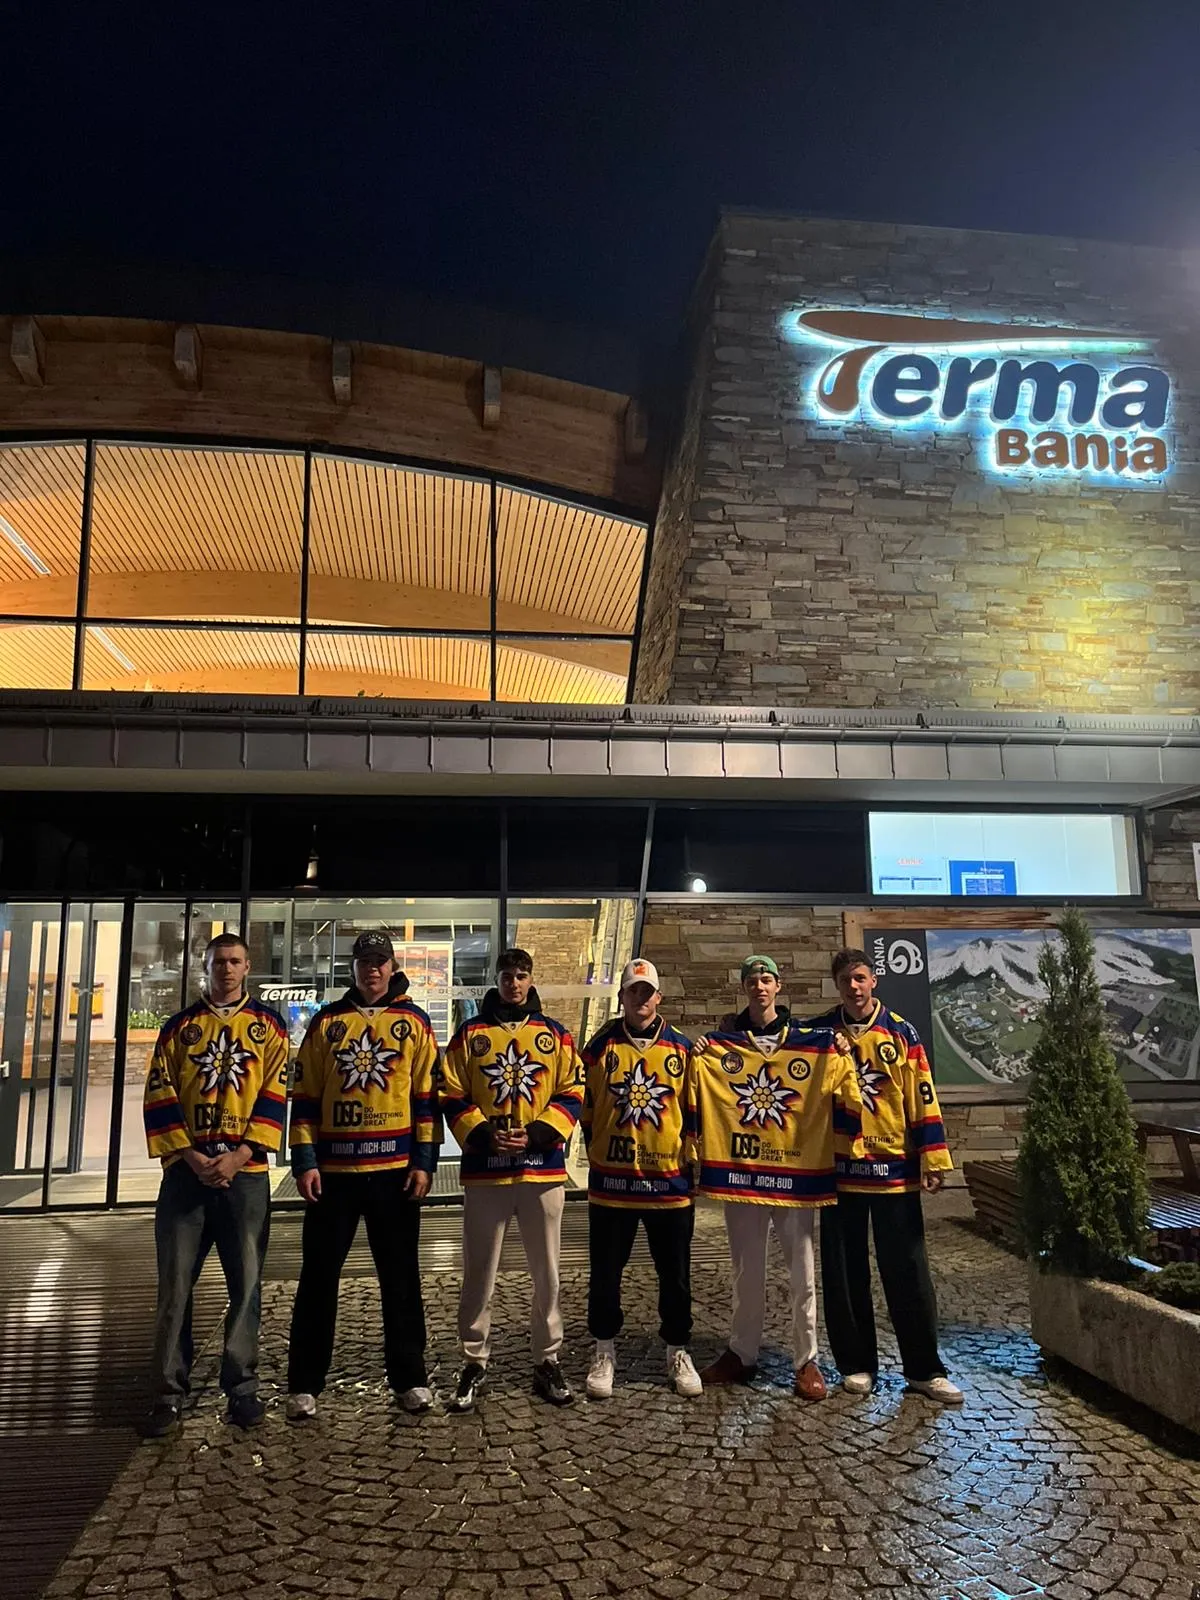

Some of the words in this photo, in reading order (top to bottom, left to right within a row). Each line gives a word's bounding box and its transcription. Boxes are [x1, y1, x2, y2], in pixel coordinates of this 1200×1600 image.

[798, 309, 1171, 432] Terma
[995, 427, 1169, 475] Bania
[873, 937, 886, 976] BANIA
[258, 983, 318, 1003] Terma
[792, 1063, 807, 1075] PZU
[919, 1081, 934, 1105] 9
[333, 1101, 363, 1128] DSG
[364, 1111, 403, 1120] SOMETHING
[357, 1140, 396, 1154] JACH-BUD
[731, 1132, 760, 1159] DSG
[862, 1135, 894, 1143] METHING
[761, 1148, 801, 1157] SOMETHING
[849, 1162, 889, 1176] JACH-BUD
[728, 1172, 751, 1185] FIRMA
[755, 1175, 793, 1189] JACH-BUD
